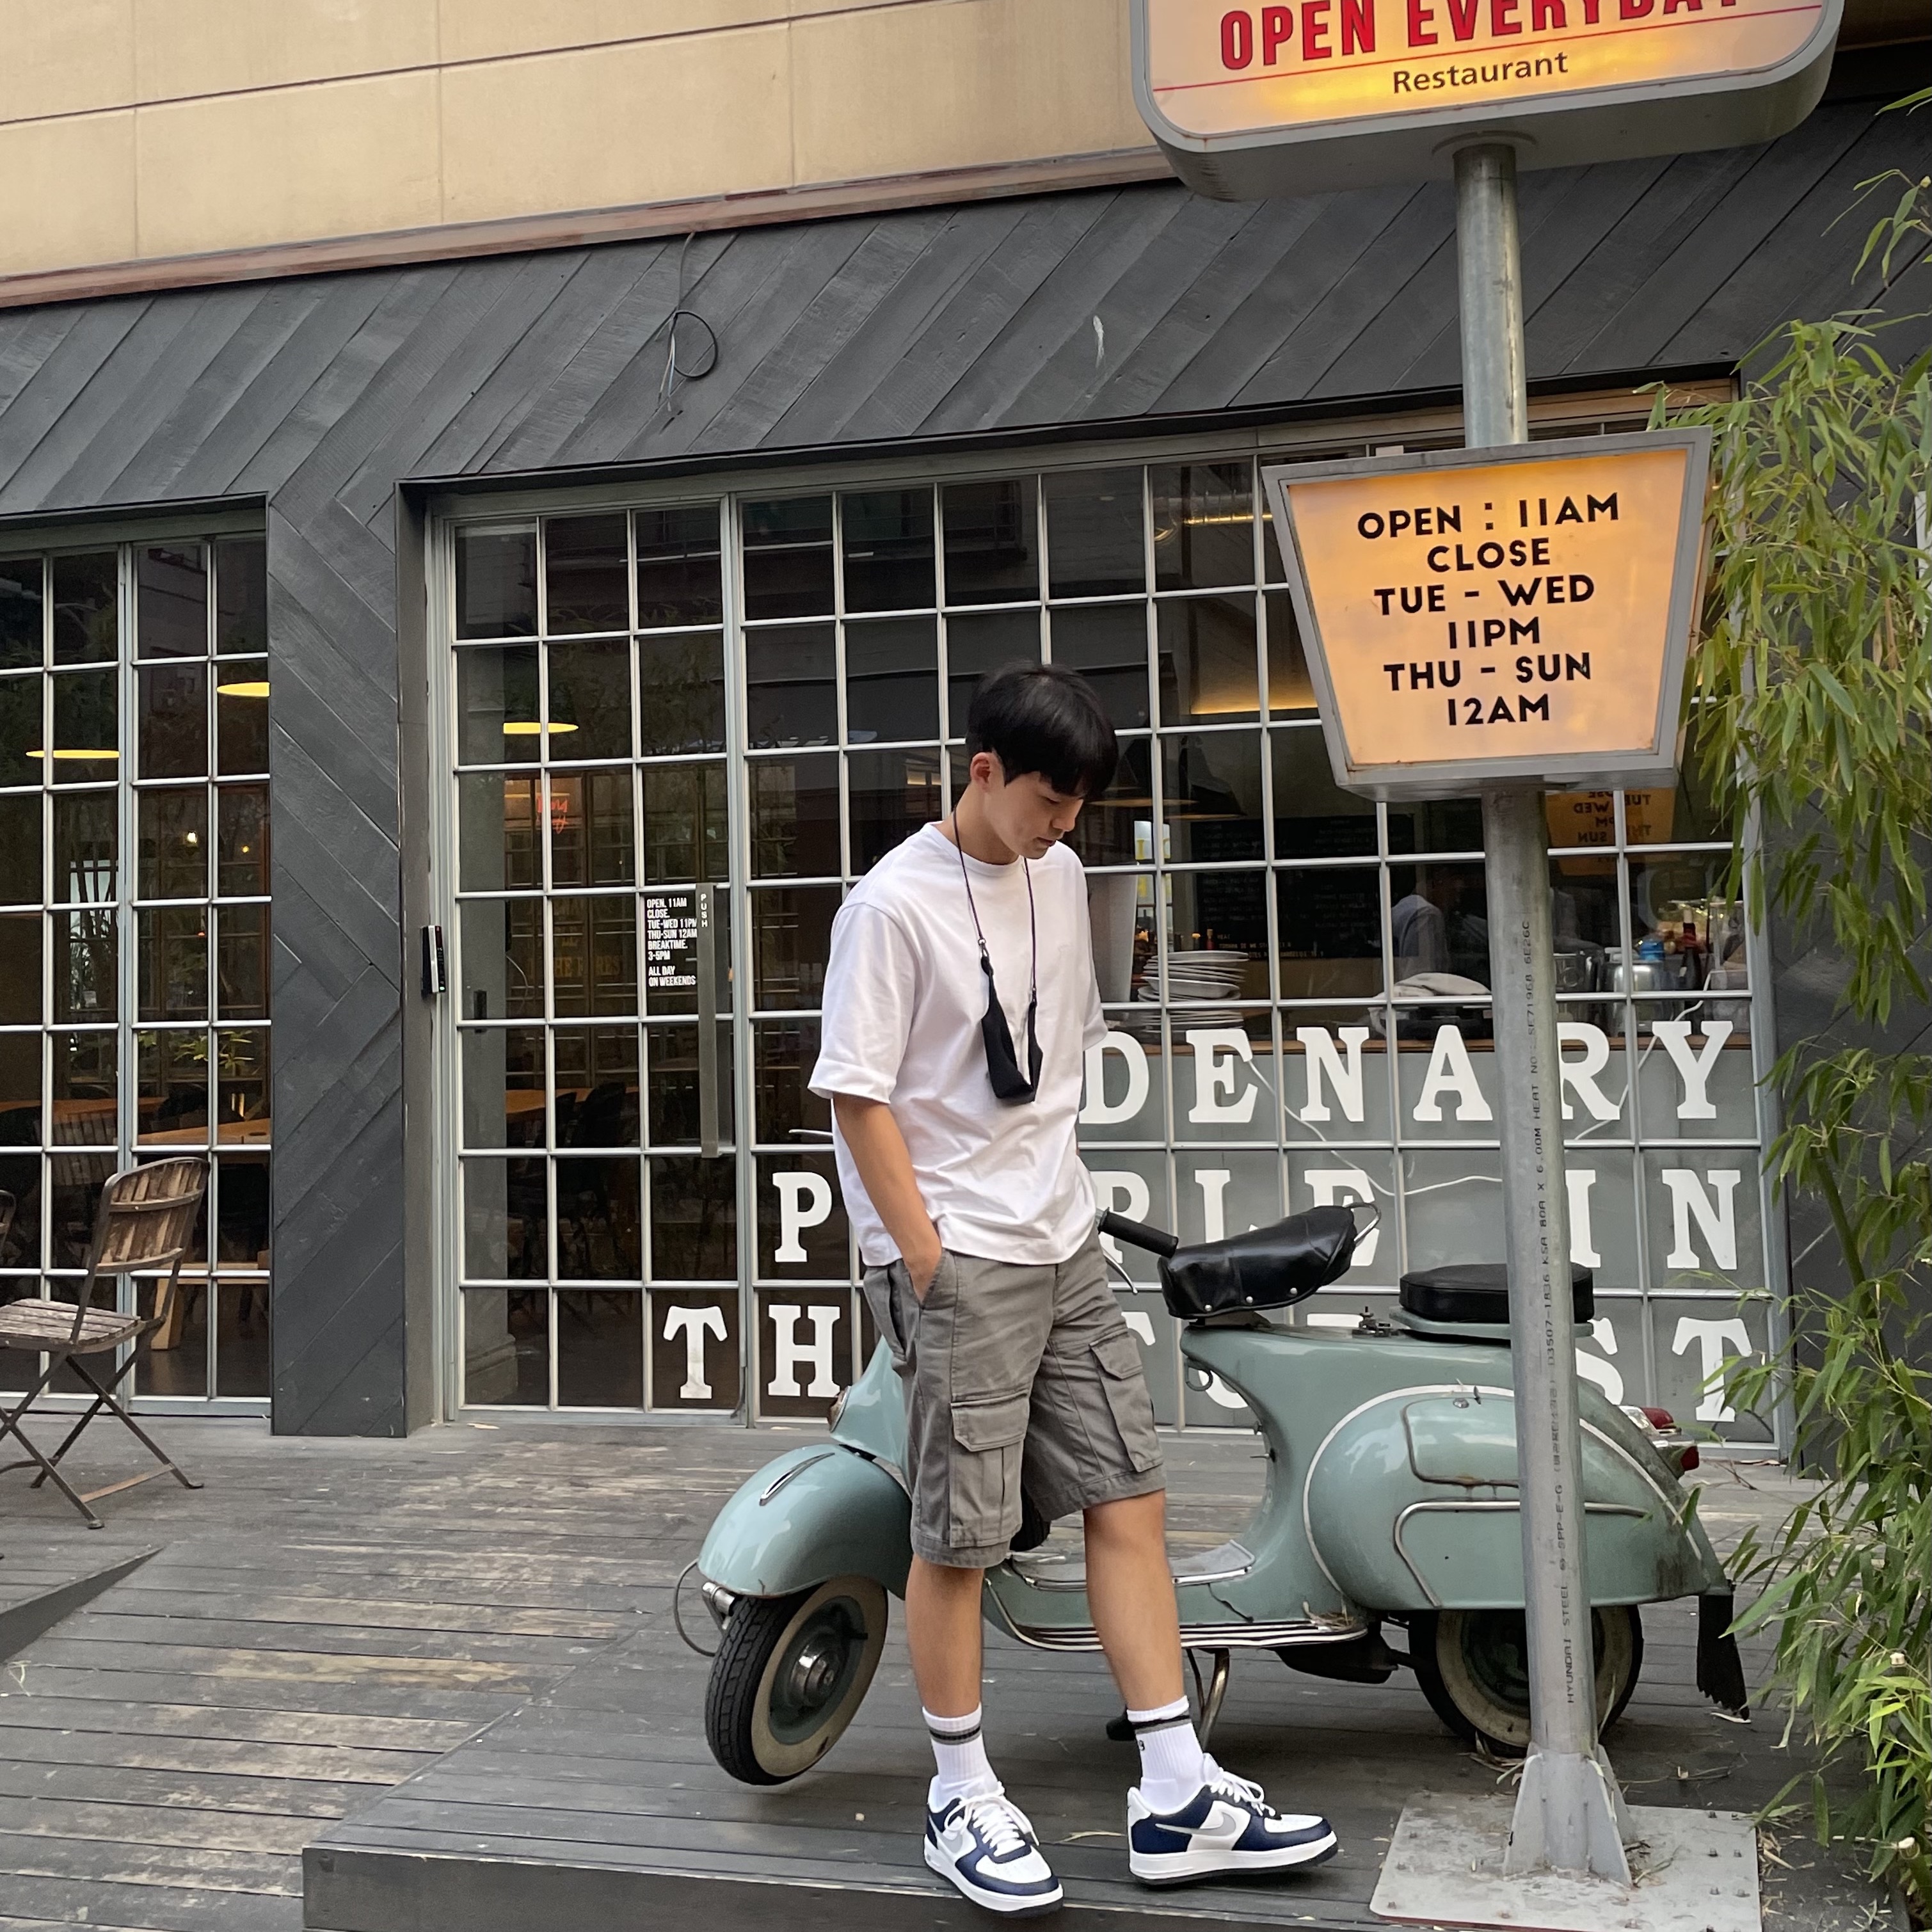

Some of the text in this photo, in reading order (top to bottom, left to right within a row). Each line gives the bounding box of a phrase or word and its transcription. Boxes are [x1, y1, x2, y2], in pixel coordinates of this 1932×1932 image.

[1220, 0, 1376, 70] OPEN
[1393, 52, 1569, 94] Restaurant
[1357, 505, 1462, 539] OPEN
[1519, 492, 1618, 527] 11AM
[1427, 537, 1550, 573] CLOSE
[1374, 584, 1446, 616] TUE
[1497, 574, 1594, 607] WED
[1448, 616, 1540, 650] 11PM
[1383, 660, 1461, 691] THU
[1515, 652, 1591, 683] SUN
[1448, 693, 1549, 726] 12AM
[669, 897, 687, 908] 11AM
[700, 893, 708, 928] PUSH
[647, 918, 698, 929] TUE-WED 11PM
[647, 928, 698, 939] THU-SUN 12AM
[648, 950, 671, 961] 3-5PM
[648, 965, 676, 976] ALL DAY
[648, 975, 696, 987] ON WEEKENDS
[1531, 1084, 1540, 1119] HEAT
[1560, 1585, 1570, 1627] STEEL
[1563, 1638, 1574, 1704] HYUNDAI
